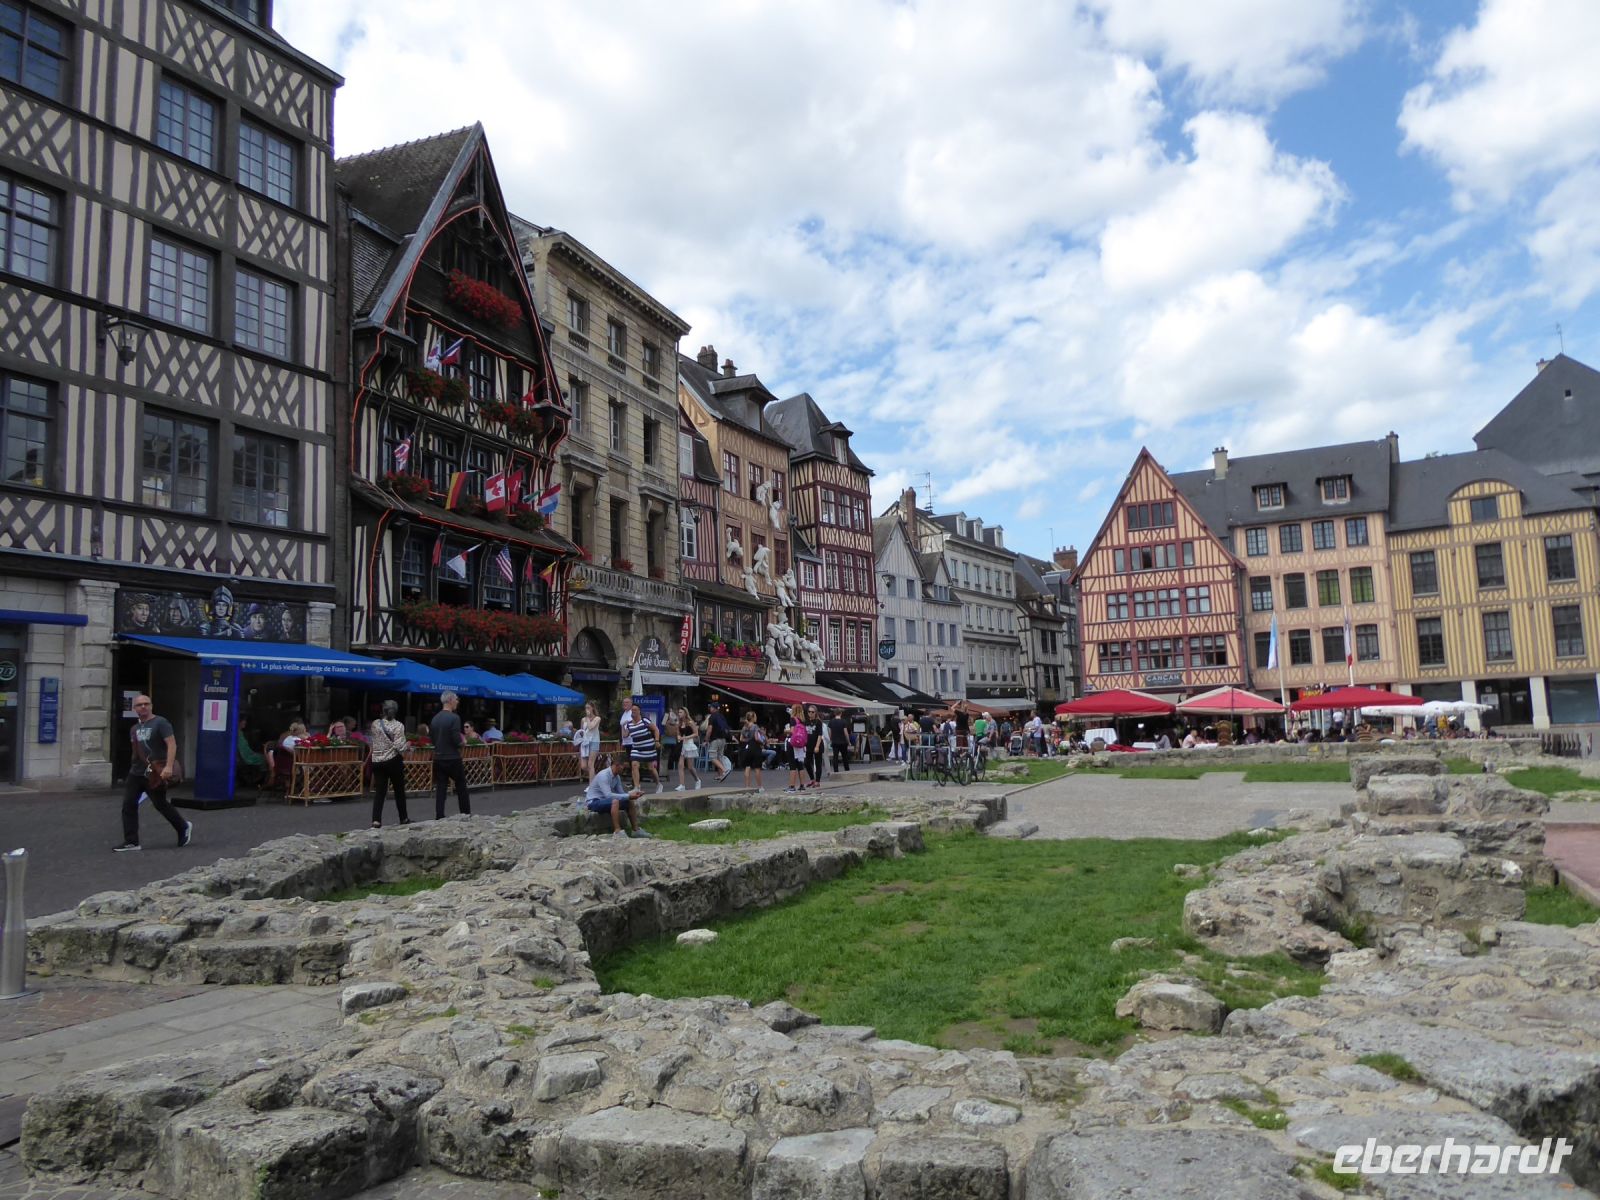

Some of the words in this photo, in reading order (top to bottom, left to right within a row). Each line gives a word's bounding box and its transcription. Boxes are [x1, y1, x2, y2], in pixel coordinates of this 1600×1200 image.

[680, 615, 690, 653] TABAC
[269, 664, 282, 672] plus
[300, 664, 323, 673] auberge
[1146, 674, 1180, 682] CANCAN
